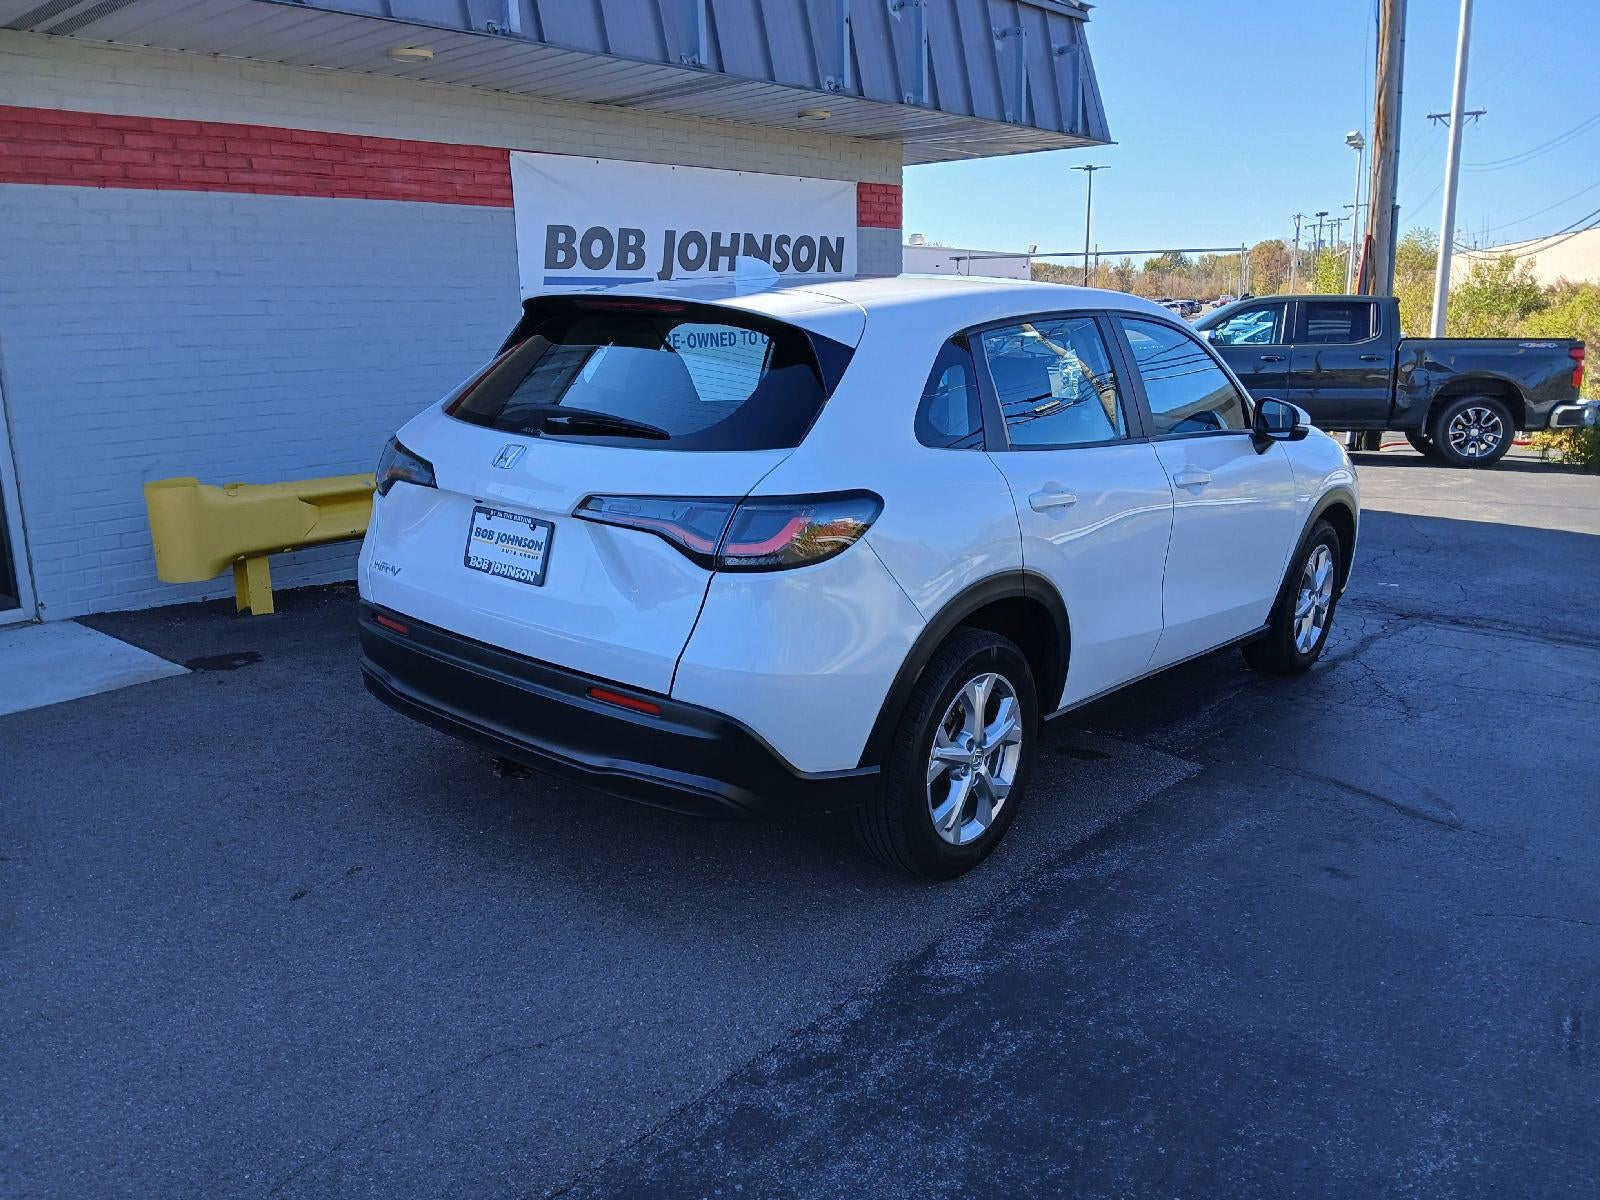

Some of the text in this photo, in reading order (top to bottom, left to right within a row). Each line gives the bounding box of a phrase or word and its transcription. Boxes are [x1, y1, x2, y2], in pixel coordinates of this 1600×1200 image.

[544, 225, 845, 281] BOB JOHNSON
[740, 331, 757, 345] TO
[474, 527, 544, 551] BOB JOHNSON
[501, 548, 517, 556] AUTO
[469, 555, 536, 582] BOB JOHNSON
